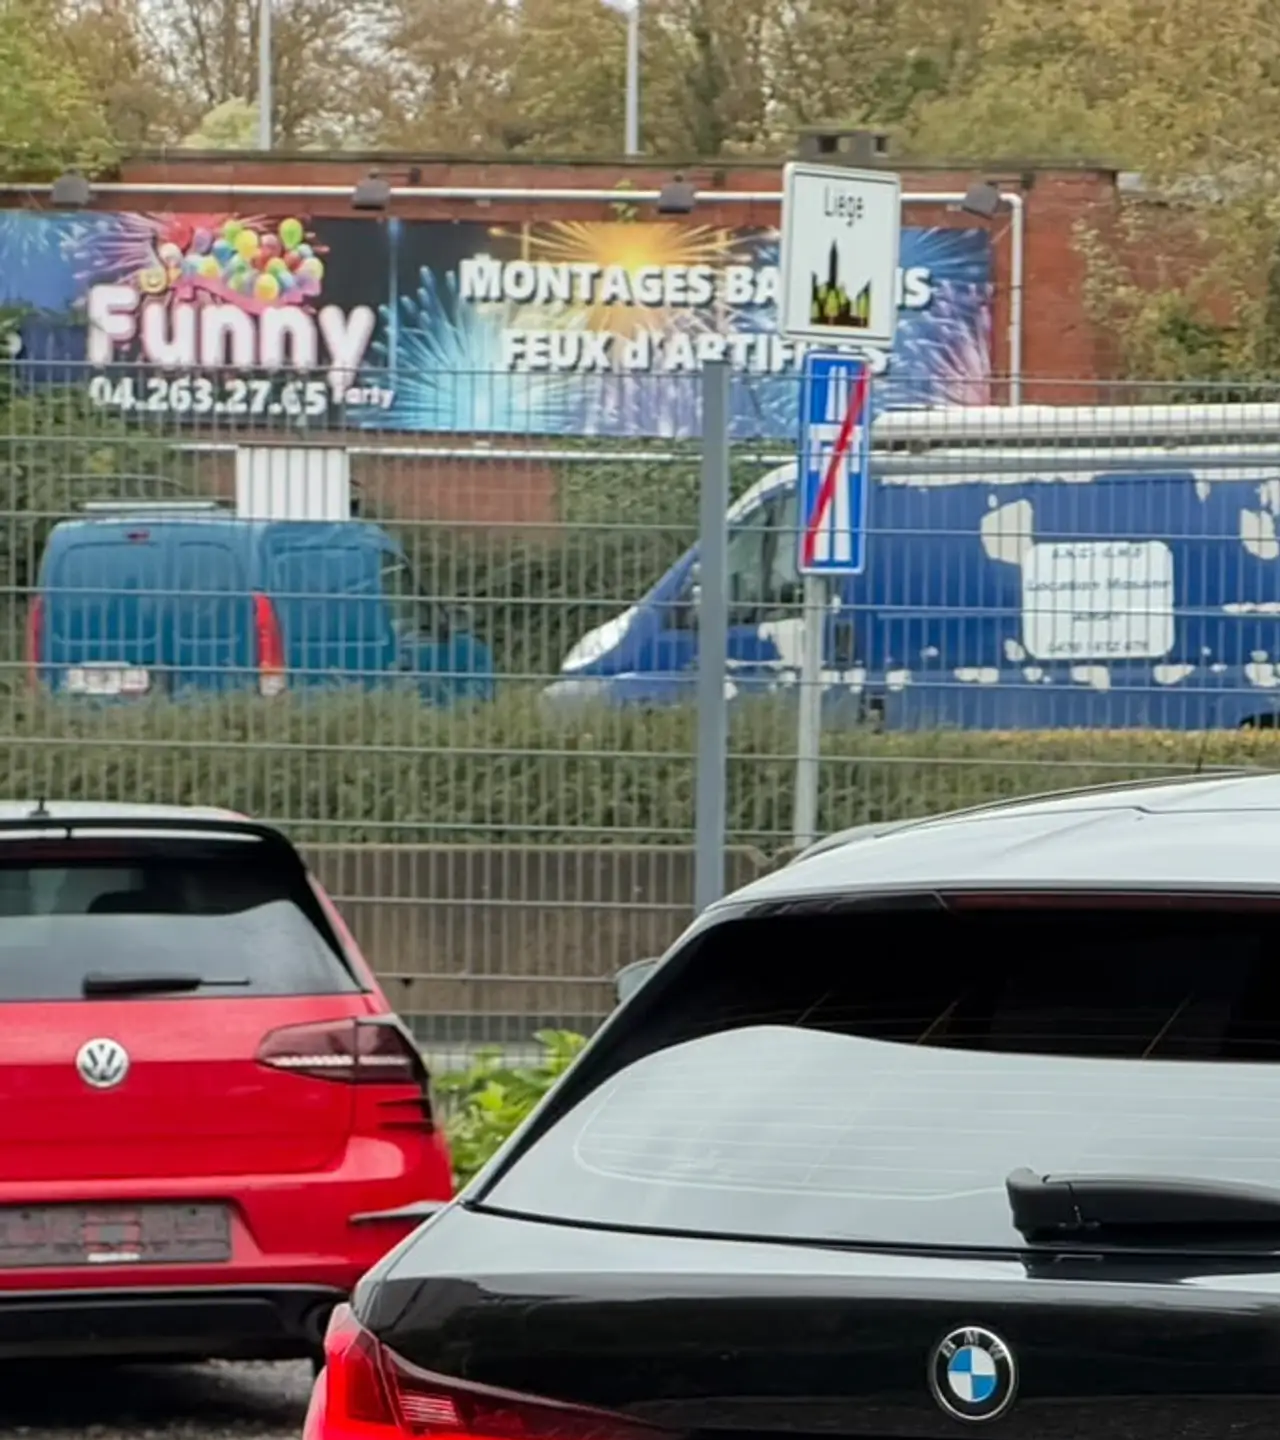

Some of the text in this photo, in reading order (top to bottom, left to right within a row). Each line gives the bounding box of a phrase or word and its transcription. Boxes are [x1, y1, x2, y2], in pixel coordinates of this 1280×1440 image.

[458, 254, 714, 306] MONTAGES
[87, 284, 377, 402] Funny
[502, 329, 617, 373] FEUX
[88, 375, 328, 416] 04.263.27.65
[939, 1328, 1008, 1361] BMW
